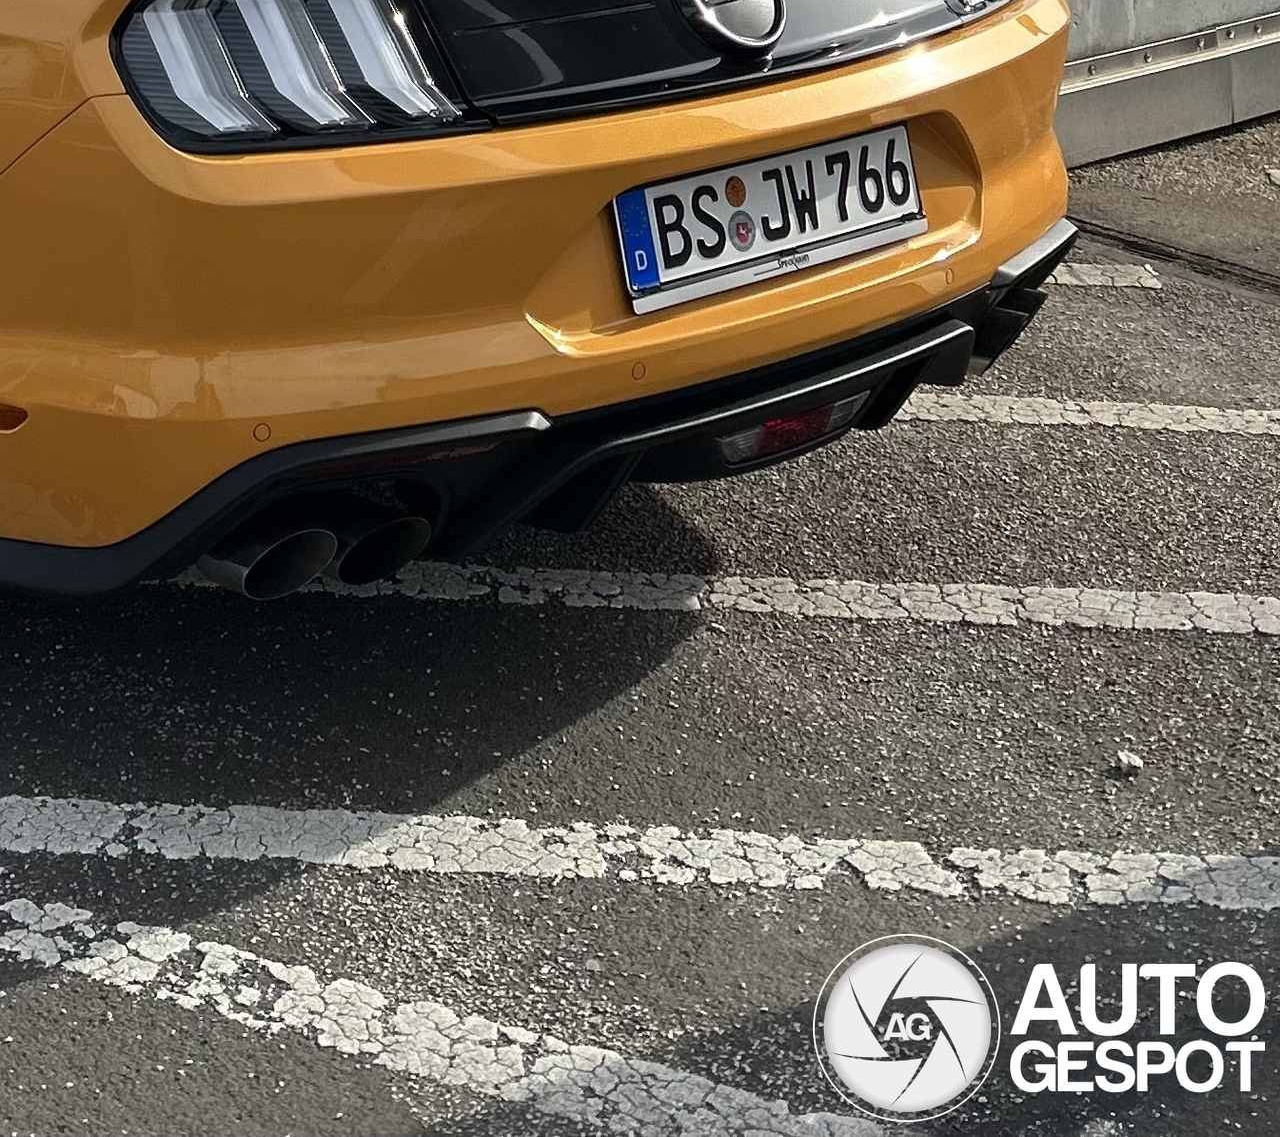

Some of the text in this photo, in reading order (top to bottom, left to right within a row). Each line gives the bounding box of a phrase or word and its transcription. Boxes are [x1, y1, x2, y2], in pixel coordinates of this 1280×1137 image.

[635, 137, 912, 271] D BS JW 766
